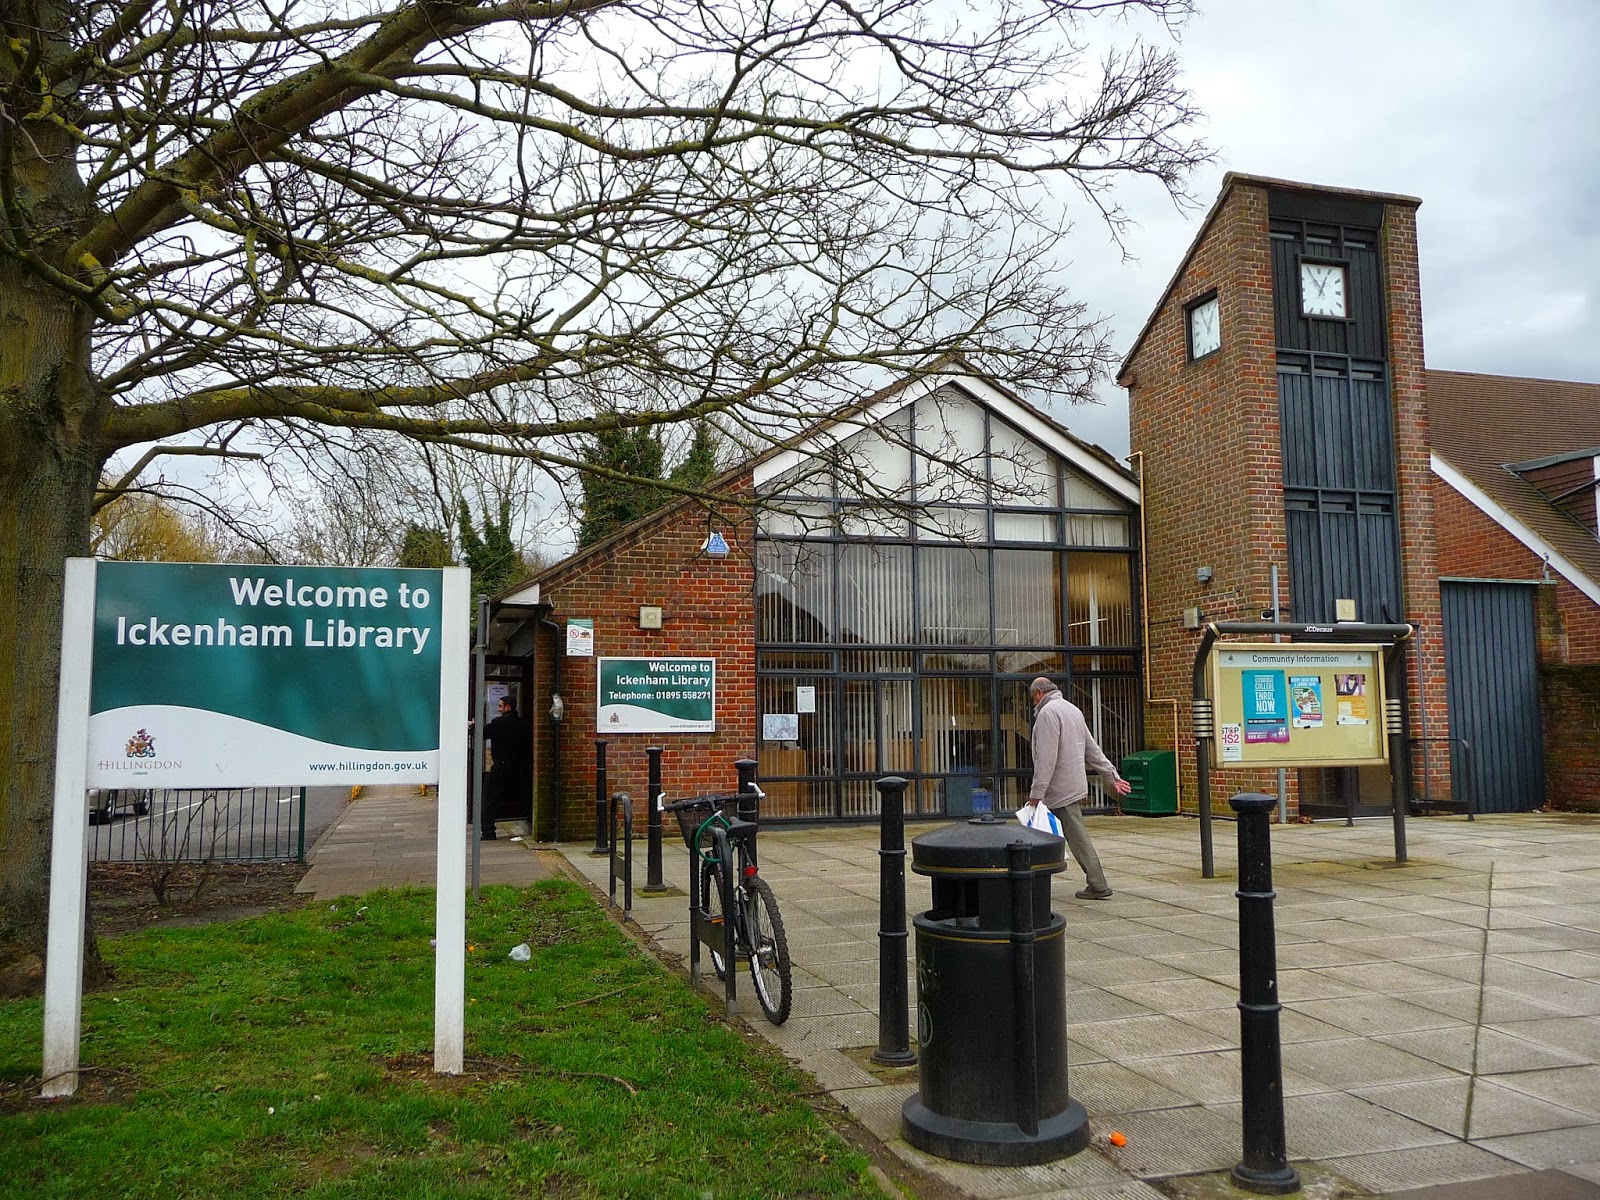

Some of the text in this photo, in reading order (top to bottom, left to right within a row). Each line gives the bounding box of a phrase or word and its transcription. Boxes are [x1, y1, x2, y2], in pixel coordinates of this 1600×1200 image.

[229, 577, 430, 609] Welcome to
[116, 616, 431, 655] Ickenham Library
[1252, 654, 1339, 664] Community Information
[649, 662, 710, 673] Welcome to
[616, 675, 710, 688] Ickenham Library
[609, 691, 711, 701] Telephone: 01895 558271
[1255, 691, 1275, 701] ENROL
[1256, 700, 1275, 712] NOW
[97, 760, 182, 770] HILLINGDON
[309, 760, 428, 773] www.hillingdon.gov.uk
